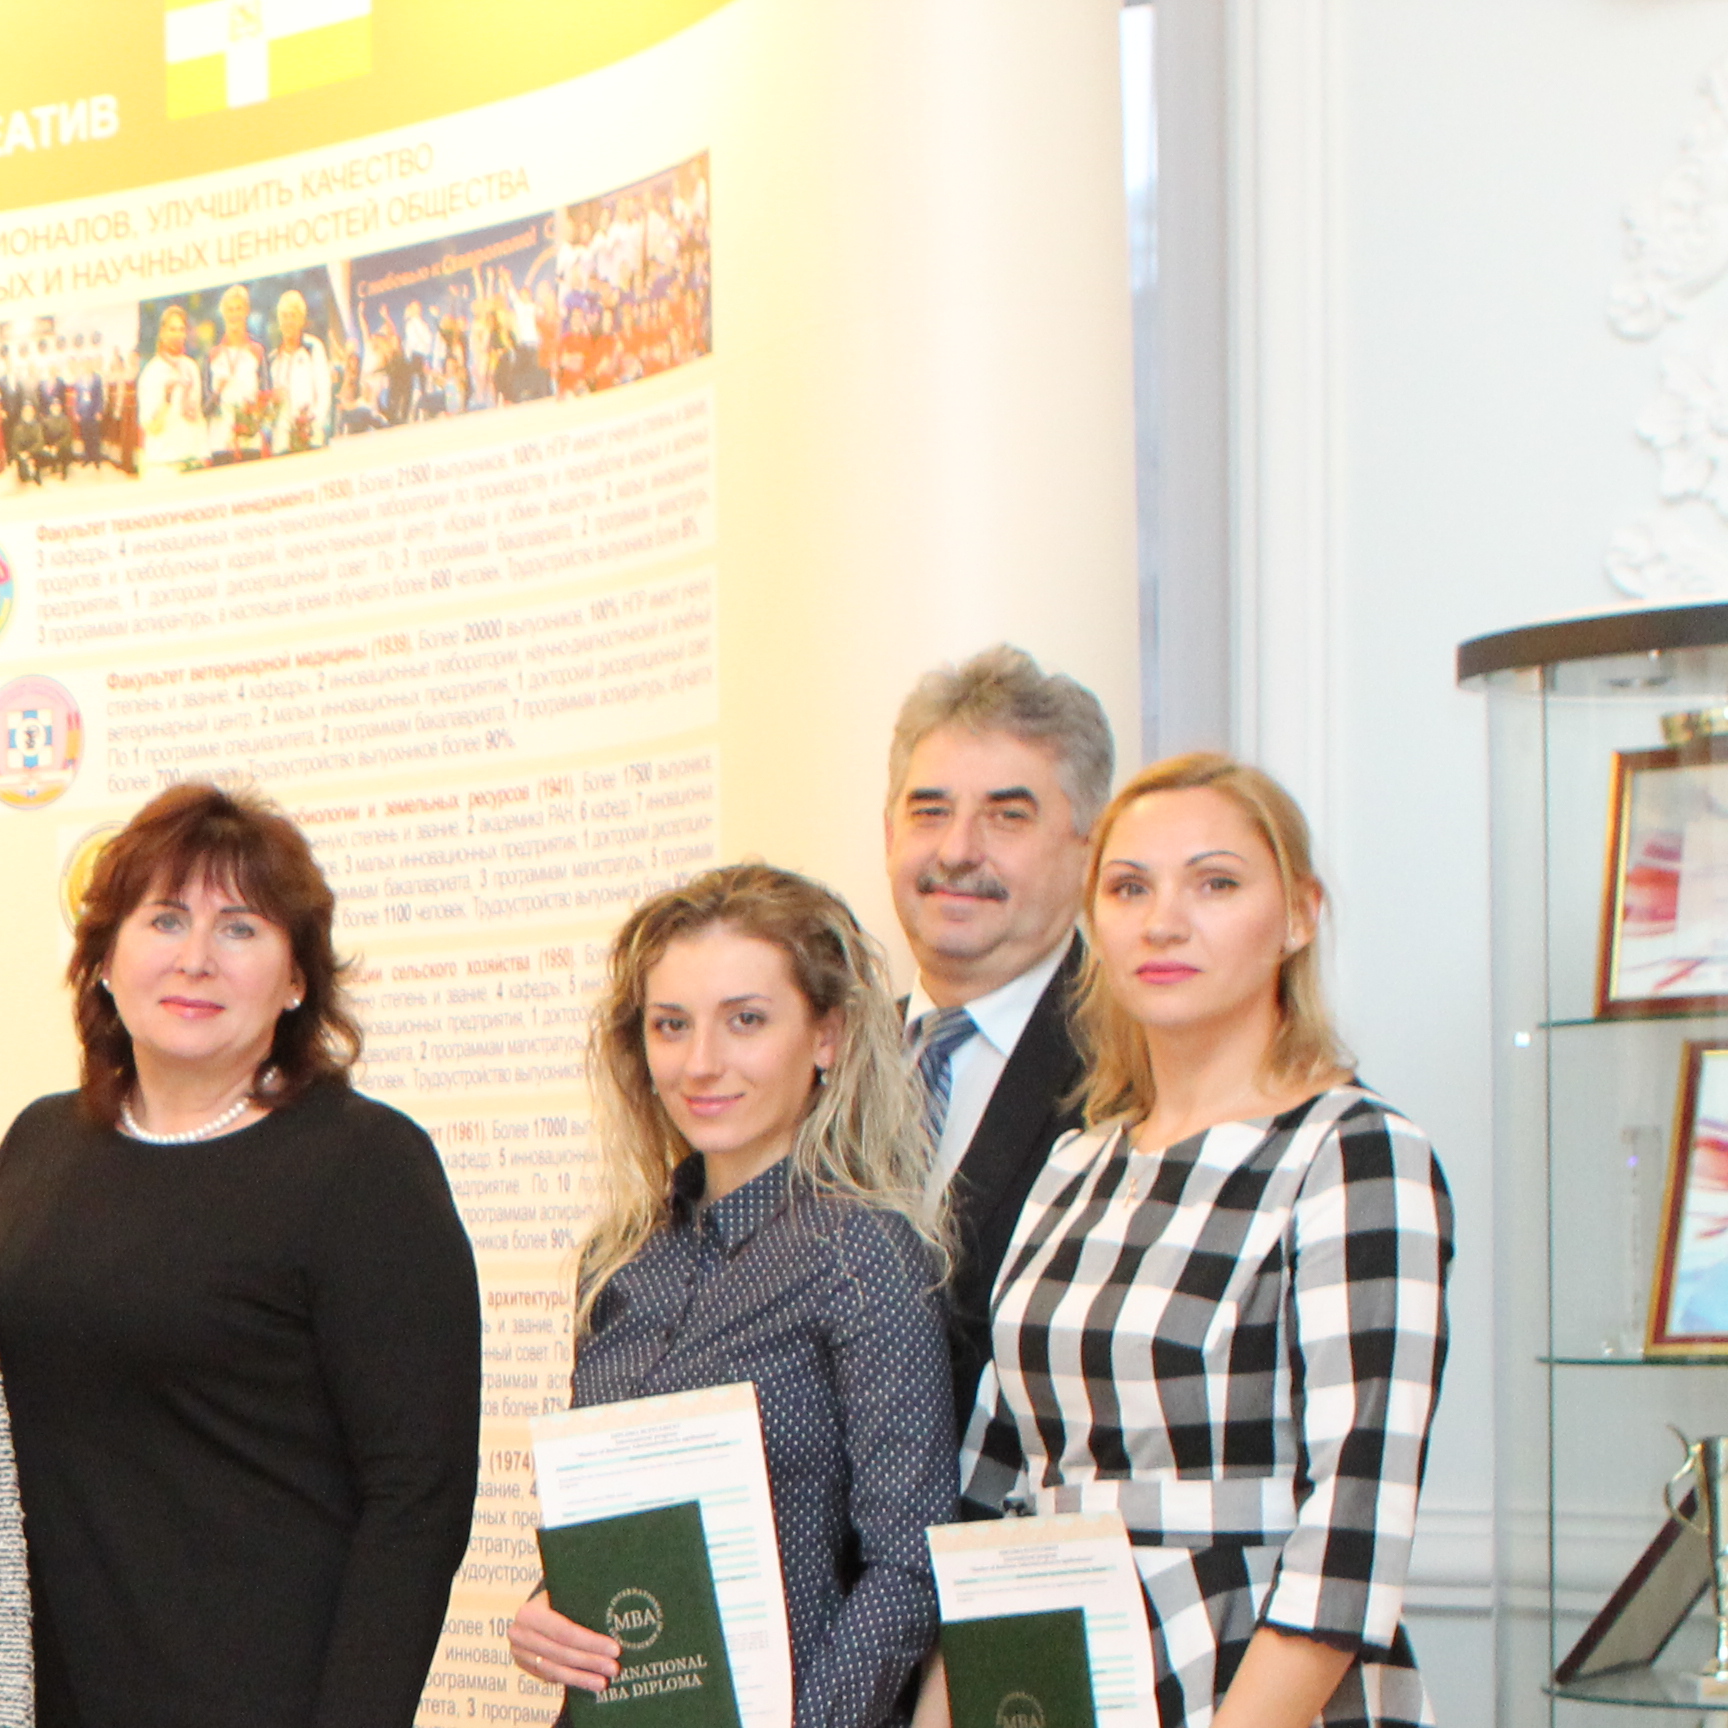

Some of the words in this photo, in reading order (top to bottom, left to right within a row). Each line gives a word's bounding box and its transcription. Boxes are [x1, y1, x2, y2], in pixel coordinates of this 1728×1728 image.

[146, 178, 296, 234] УЛУЧШИТЬ
[300, 141, 434, 198] КАЧЕСТВО
[43, 265, 63, 294] И
[72, 242, 211, 288] НАУЧНЫХ
[215, 203, 381, 272] ЦЕННОСТЕЙ
[386, 167, 532, 230] ОБЩЕСТВА
[105, 663, 185, 693] Факультет
[613, 1607, 657, 1631] MBA
[595, 1685, 630, 1703] MBA
[632, 1672, 703, 1697] DIPLOMA
